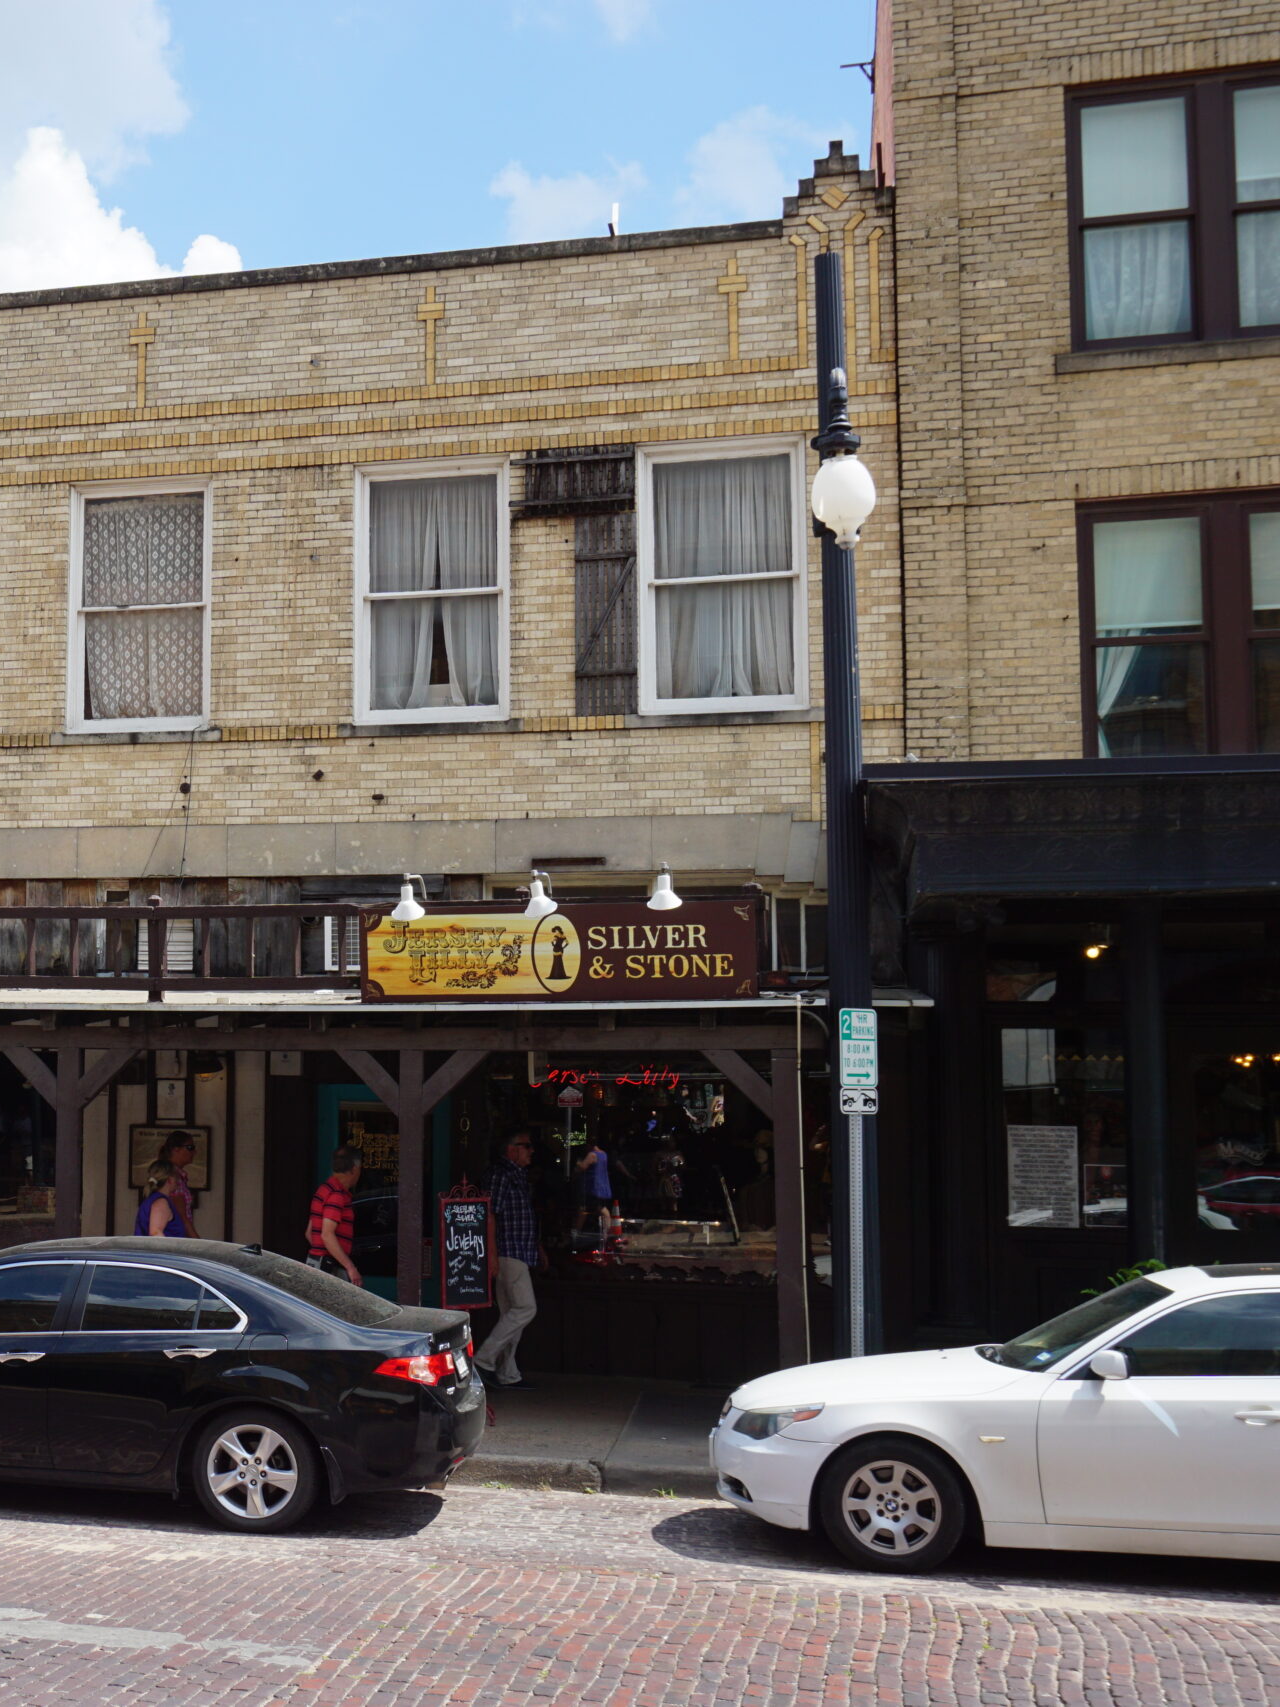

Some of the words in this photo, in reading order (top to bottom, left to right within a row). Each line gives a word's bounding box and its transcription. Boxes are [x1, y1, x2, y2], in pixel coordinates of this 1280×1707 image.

[383, 920, 506, 954] JERSEY
[588, 924, 708, 950] SILVER
[408, 948, 494, 983] LILLY
[588, 956, 615, 979] &
[626, 953, 734, 979] STONE
[842, 1014, 851, 1034] 2
[856, 1014, 868, 1024] HR
[852, 1026, 874, 1036] PARKING
[847, 1043, 860, 1054] 8:00
[861, 1044, 870, 1054] AM
[844, 1058, 851, 1068] TO
[866, 1059, 874, 1068] PM
[446, 1226, 485, 1258] JEWELRY
